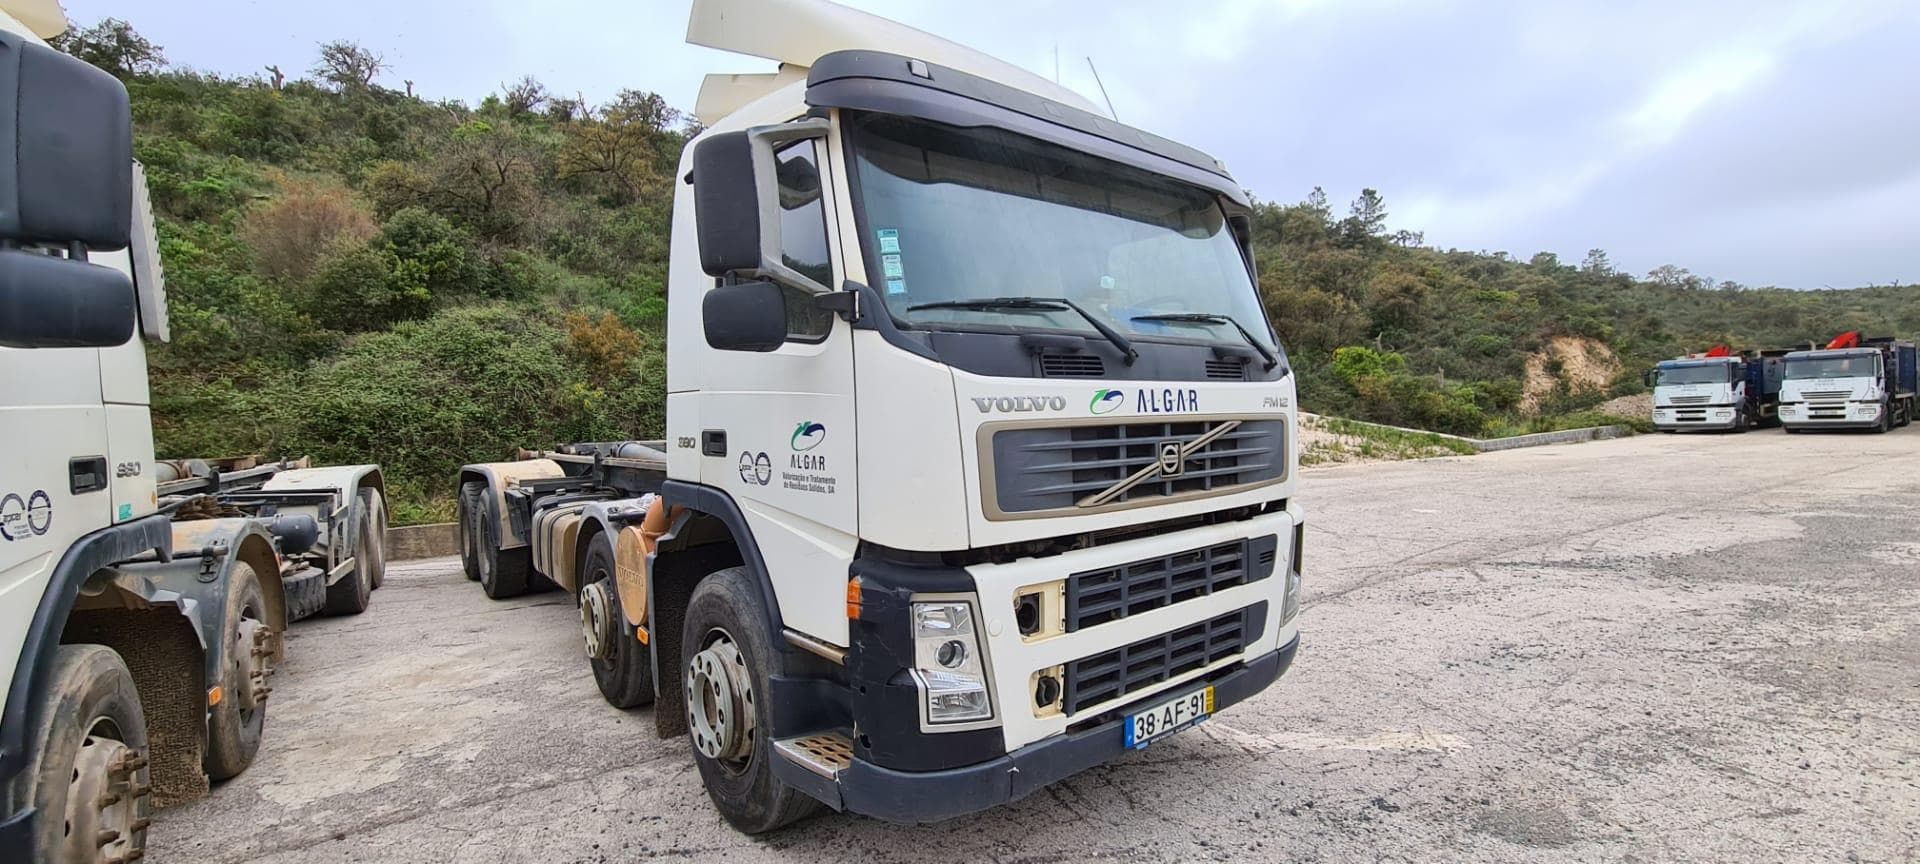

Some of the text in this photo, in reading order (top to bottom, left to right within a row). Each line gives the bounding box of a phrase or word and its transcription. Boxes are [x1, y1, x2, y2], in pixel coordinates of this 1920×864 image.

[971, 395, 1066, 414] VOLVO
[1137, 388, 1199, 413] ALGAR
[1262, 396, 1289, 408] FM12
[790, 453, 826, 472] ALGAR
